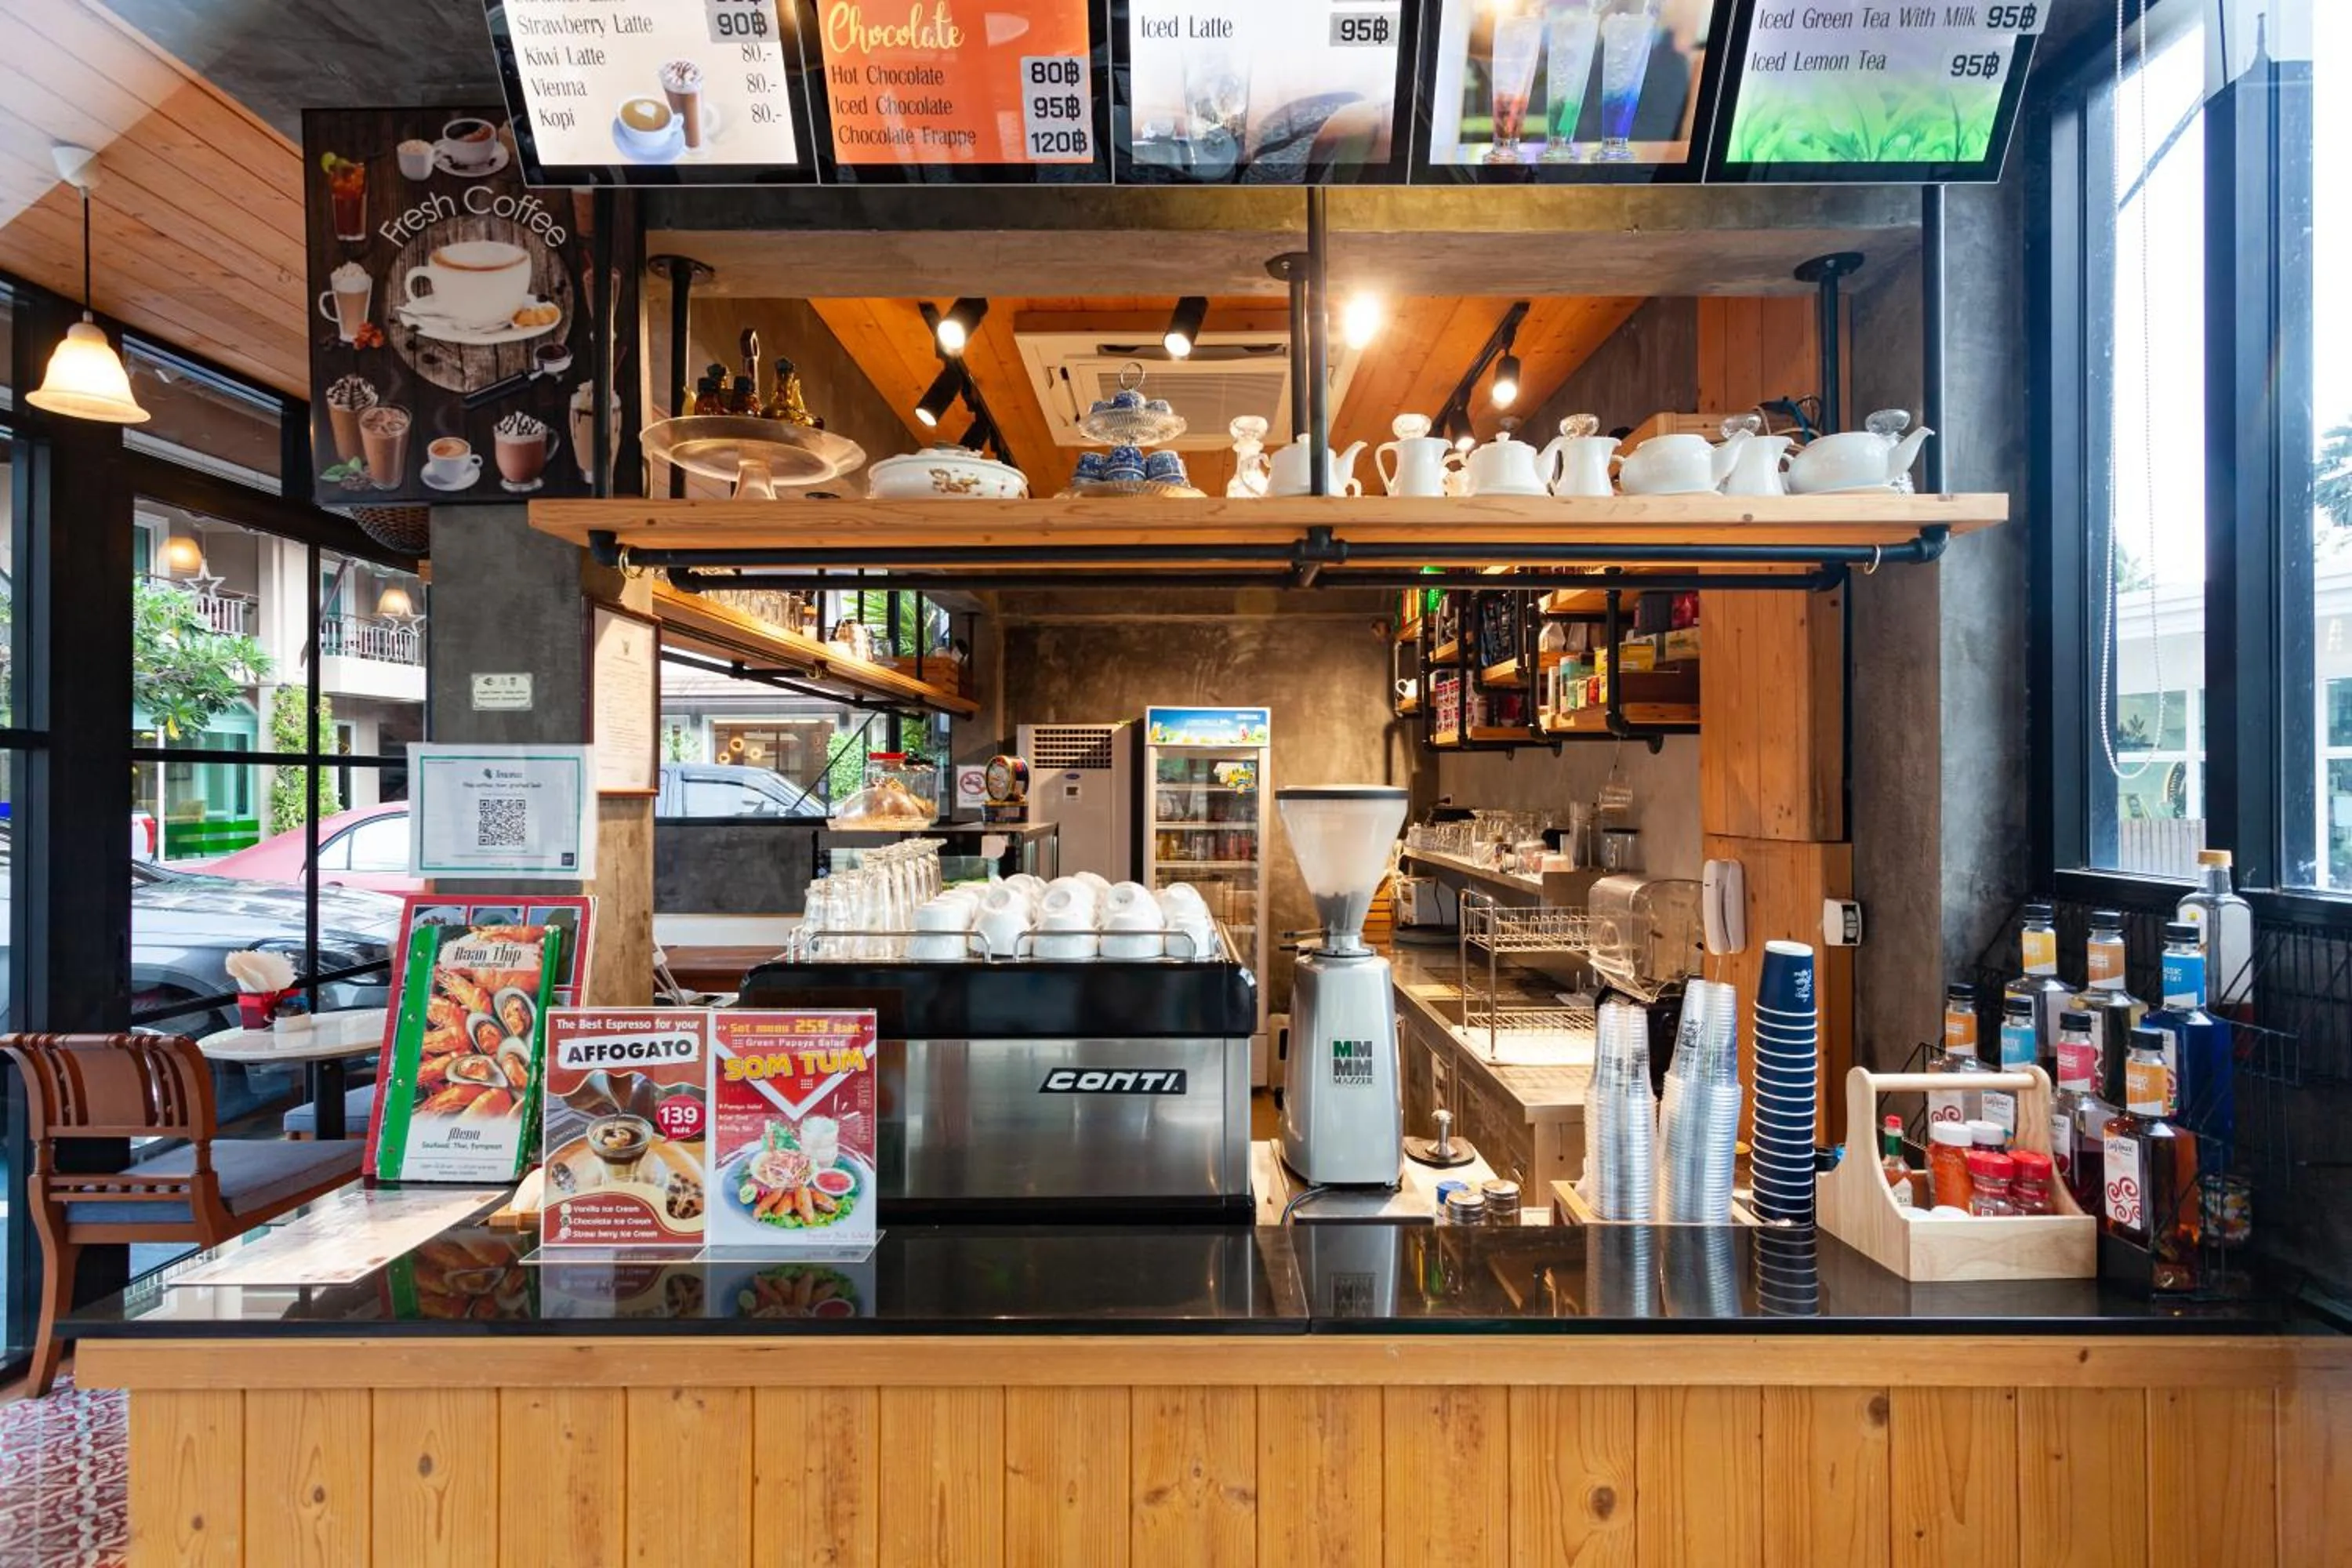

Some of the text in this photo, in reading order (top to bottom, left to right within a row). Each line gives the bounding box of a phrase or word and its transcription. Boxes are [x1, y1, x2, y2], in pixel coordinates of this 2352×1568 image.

[517, 13, 606, 38] Strawberry
[613, 13, 654, 34] Latte
[827, 2, 966, 54] Chocolate
[1141, 15, 1178, 38] Iced
[1189, 15, 1233, 38] Latte
[1759, 9, 1794, 30] Iced
[1802, 8, 1853, 30] Green
[1860, 7, 1889, 28] Tea
[1899, 6, 1935, 28] With
[1942, 6, 1977, 27] Milk
[524, 46, 561, 66] Kiwi
[567, 45, 606, 66] Latte
[1751, 52, 1785, 71] Iced
[1794, 51, 1849, 71] Lemon
[1858, 49, 1887, 70] Tea
[831, 65, 858, 85] Hot
[866, 65, 945, 85] Chocolate
[531, 77, 587, 97] Vienna
[835, 96, 867, 114] Iced
[876, 96, 953, 116] Chocolate
[539, 107, 575, 129] Kopi
[838, 125, 915, 146] Chocolate
[922, 126, 977, 147] Frappe
[379, 186, 567, 249] Fresh Coffee
[556, 1019, 699, 1032] The Best Espresso for your
[567, 1040, 692, 1063] AFFOGATO
[724, 1047, 868, 1082] SOM TUM
[660, 1106, 699, 1124] 139
